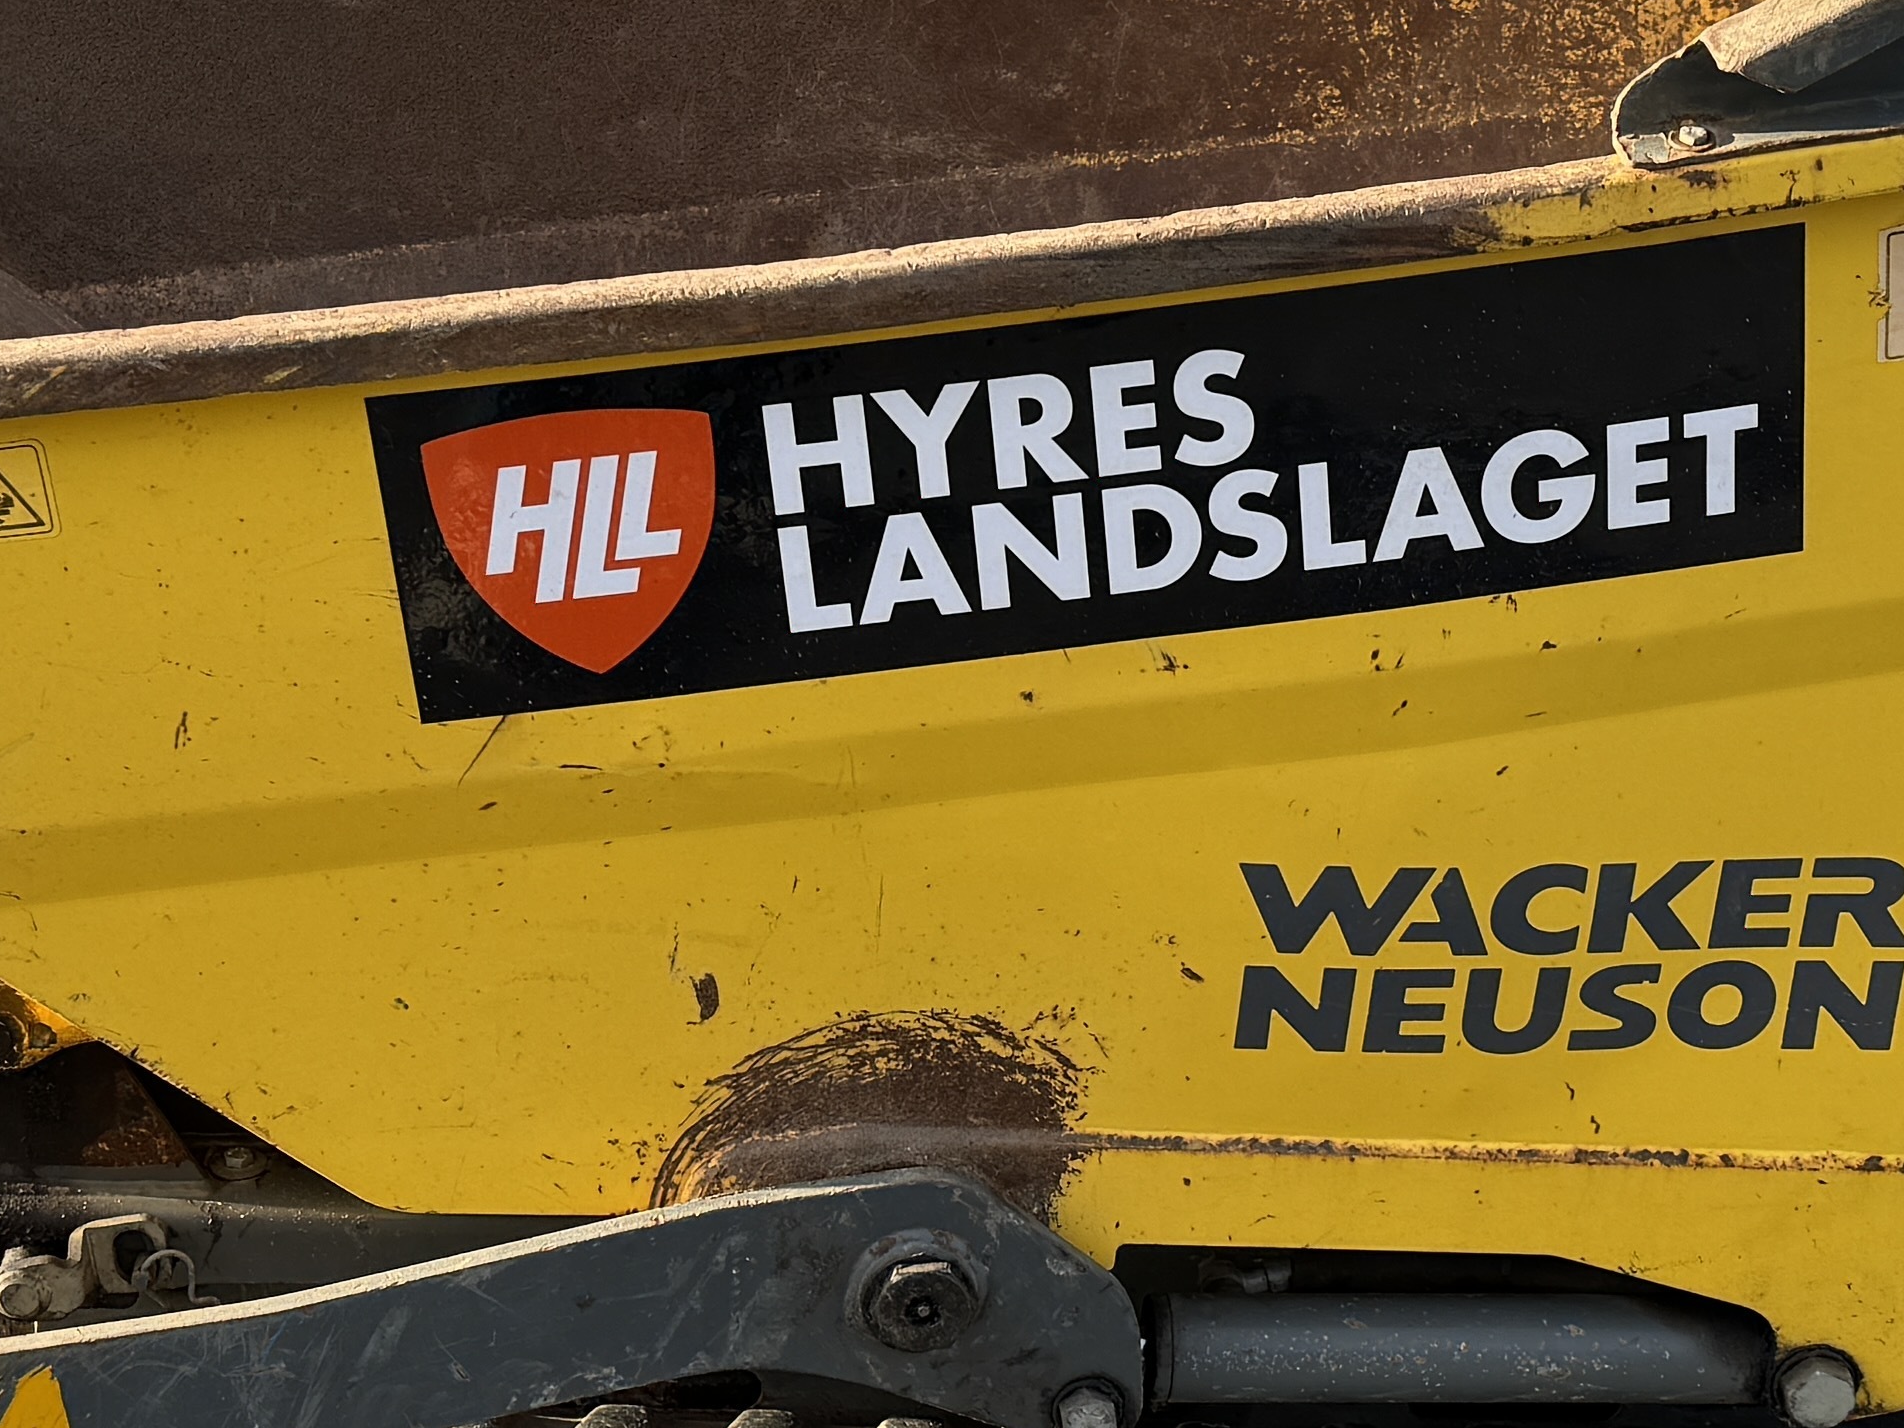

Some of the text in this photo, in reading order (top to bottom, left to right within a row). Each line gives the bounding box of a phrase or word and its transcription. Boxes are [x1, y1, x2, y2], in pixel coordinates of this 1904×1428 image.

[761, 348, 1257, 516] HYRES
[485, 450, 683, 604] HLL
[777, 402, 1760, 634] LANDSLAGET
